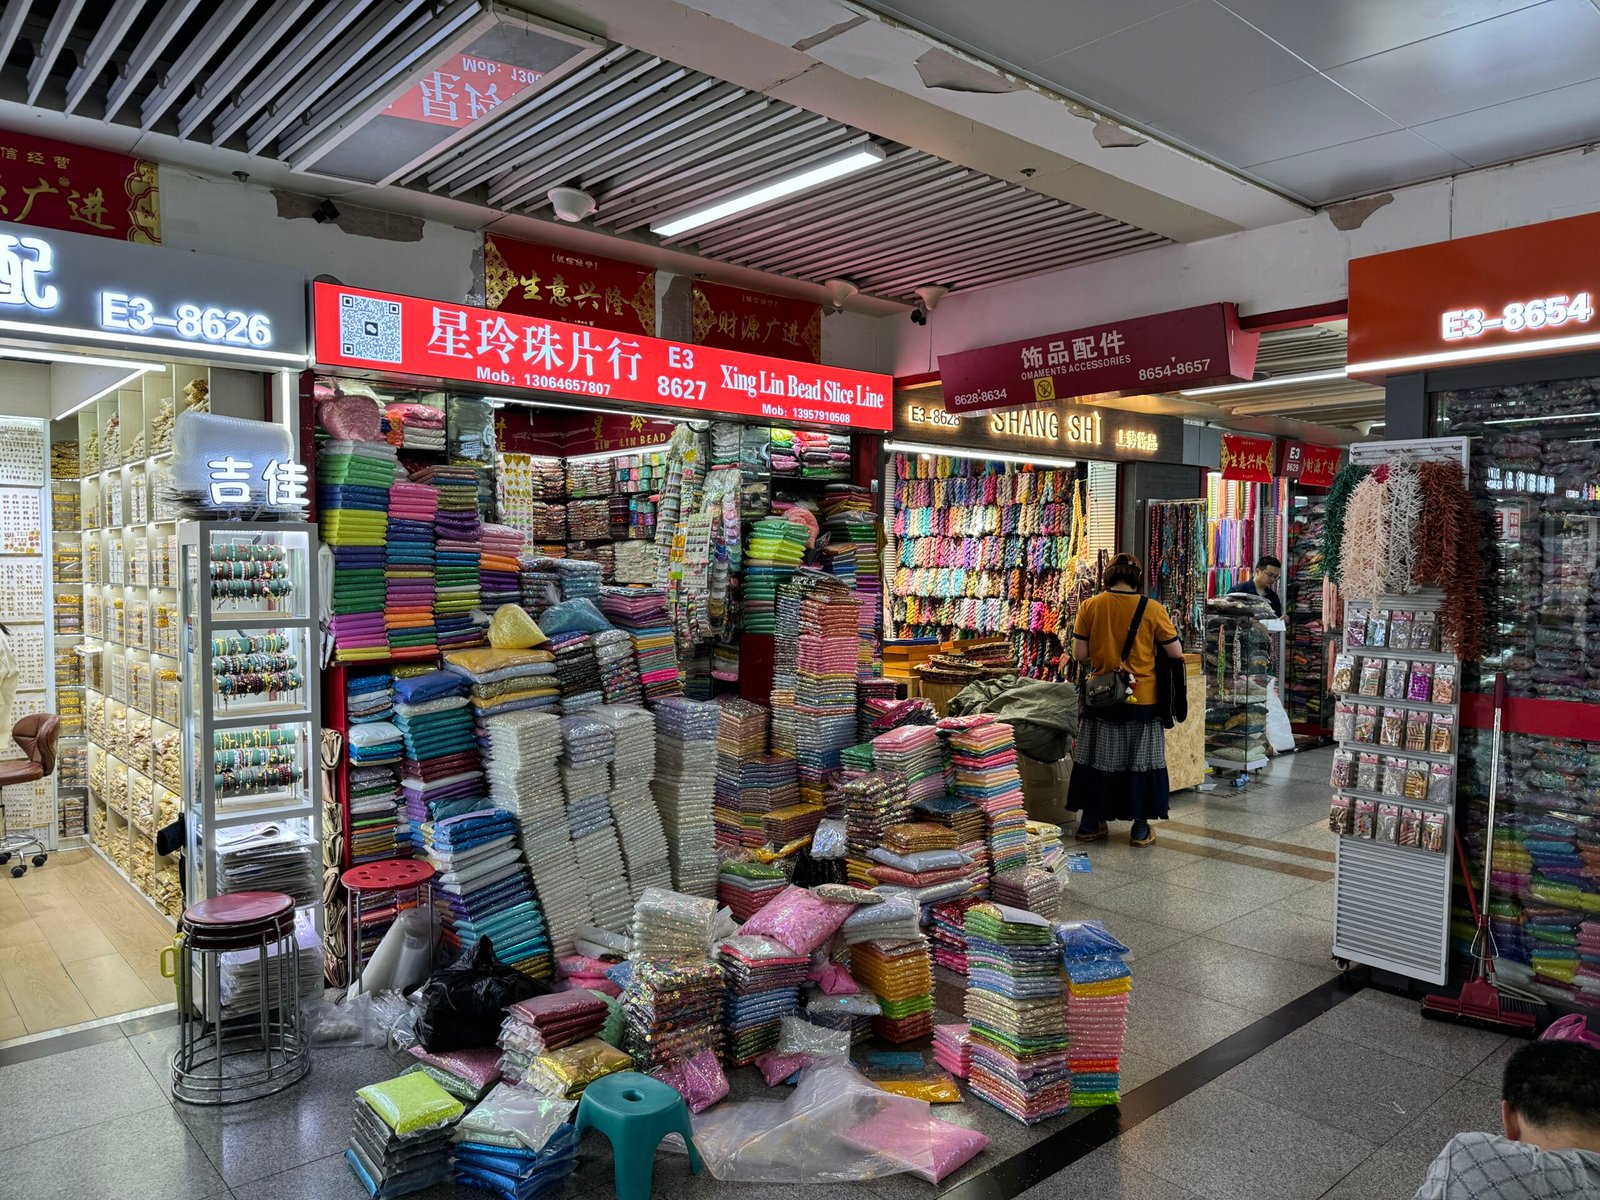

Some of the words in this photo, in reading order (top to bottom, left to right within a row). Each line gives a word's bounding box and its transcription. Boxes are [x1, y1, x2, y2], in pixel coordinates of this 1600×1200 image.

[0, 176, 116, 231] 广进
[520, 269, 631, 316] 生意兴隆
[101, 292, 272, 346] E3-8626
[717, 310, 802, 347] 财源广进
[1442, 292, 1593, 340] E3-8654
[427, 306, 643, 381] 星玲珠片行
[668, 346, 694, 370] E3
[1021, 330, 1125, 369] 饰品配件
[1069, 354, 1131, 373] ACCESSORIES
[1138, 358, 1212, 381] 8654-8657
[476, 365, 515, 385] Mob:
[524, 373, 611, 395] 13064657807
[657, 375, 707, 400] 8627
[720, 364, 757, 397] Xing
[760, 370, 784, 395] Lin
[788, 374, 821, 401] Bead
[824, 381, 854, 405] Slice
[856, 385, 884, 408] Line
[954, 388, 1008, 406] 8628-8634
[793, 407, 851, 423] 13957910508
[909, 405, 961, 427] E3-8628
[991, 409, 1058, 440] SHANG
[640, 432, 666, 445] BEAD
[1289, 447, 1300, 459] E3
[207, 456, 310, 506] 吉佳
